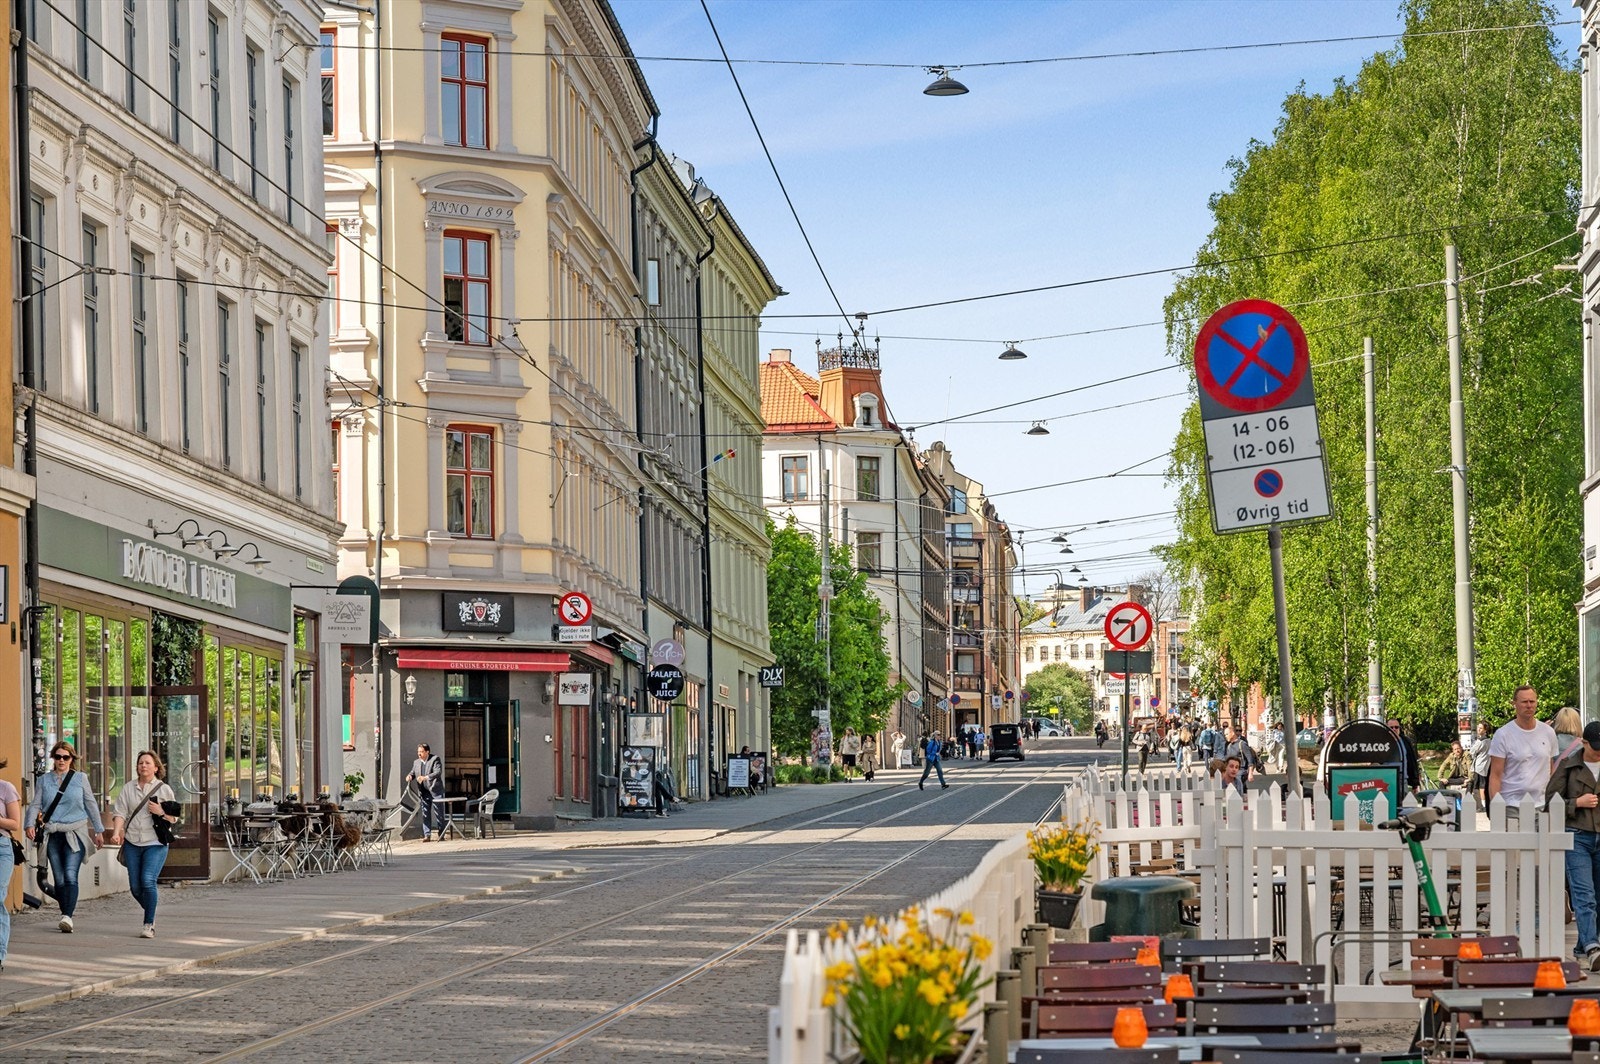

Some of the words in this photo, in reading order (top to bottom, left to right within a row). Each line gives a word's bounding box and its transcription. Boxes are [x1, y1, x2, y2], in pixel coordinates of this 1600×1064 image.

[428, 201, 469, 215] ANNO
[476, 206, 514, 219] 1899
[1232, 421, 1250, 437] 14
[1266, 415, 1289, 432] 06
[1233, 436, 1294, 462] (12-06)
[1236, 503, 1280, 521] Øvrig
[1287, 498, 1309, 514] tid
[122, 539, 188, 594] BØNDER
[189, 561, 198, 597] I
[200, 564, 236, 609] BYEN
[763, 668, 783, 681] DLX
[1339, 743, 1358, 752] LOS
[1359, 742, 1390, 752] TACOS
[1361, 781, 1375, 789] MAI
[1415, 860, 1428, 885] Bolt
